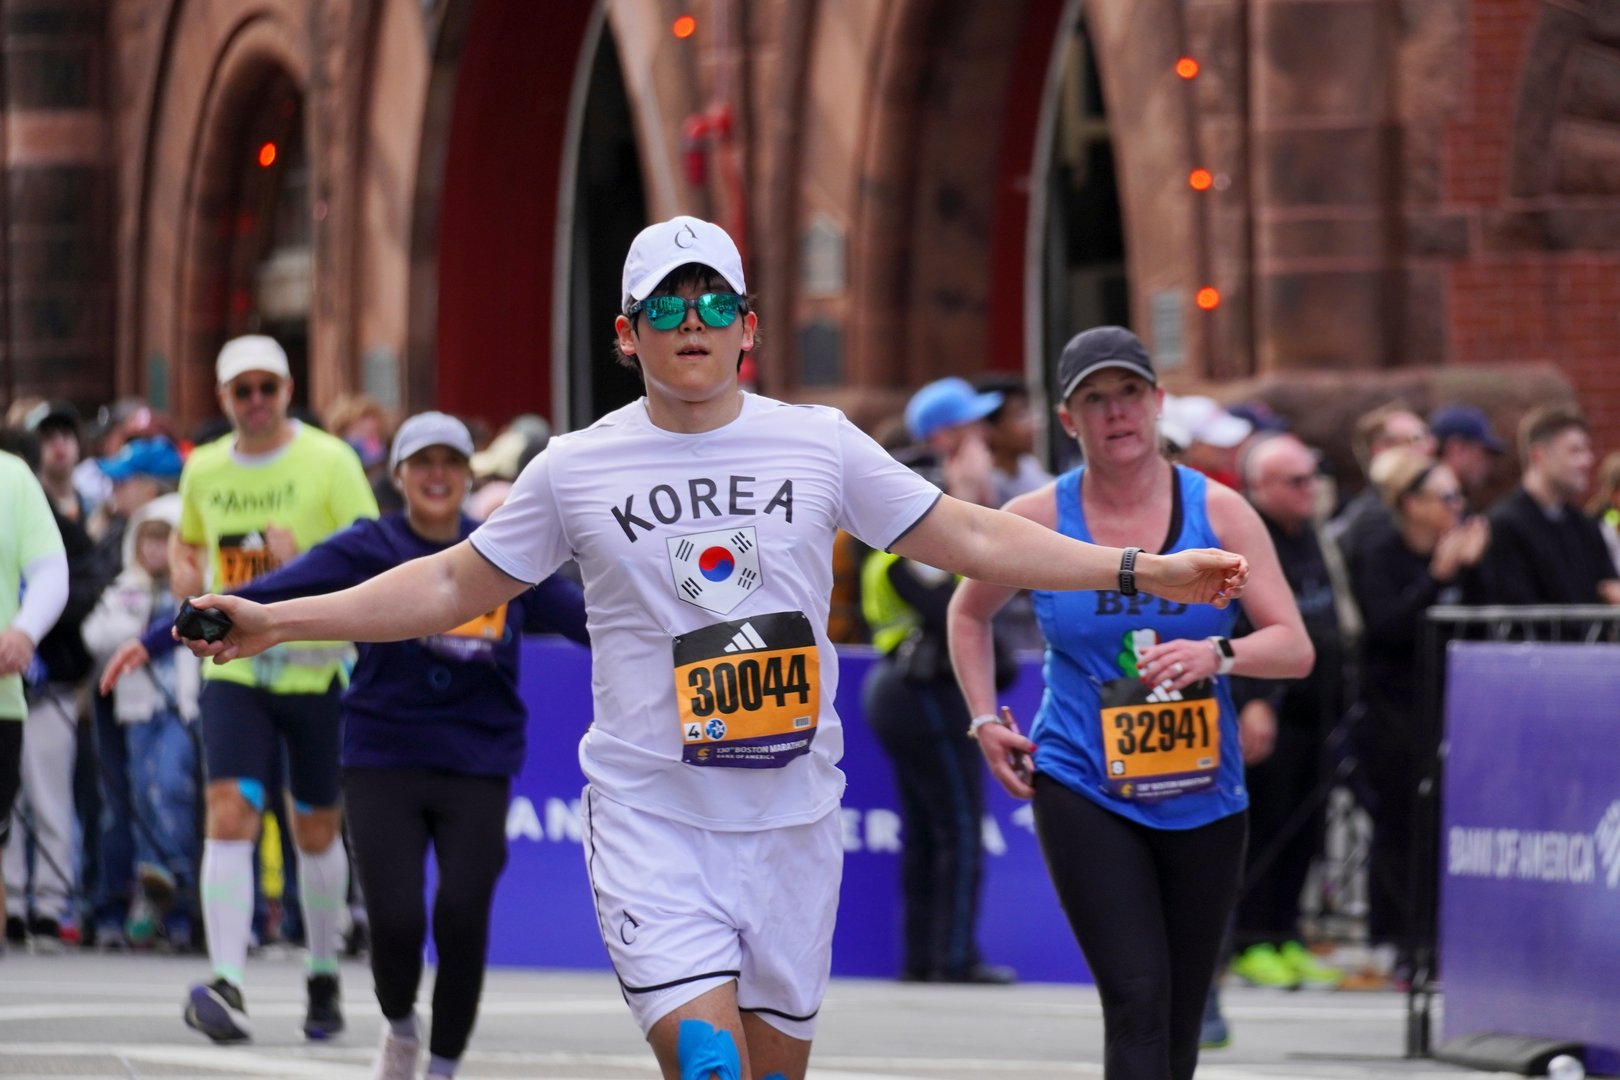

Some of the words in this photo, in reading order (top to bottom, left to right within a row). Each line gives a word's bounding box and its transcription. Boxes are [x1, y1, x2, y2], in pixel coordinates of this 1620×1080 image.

[611, 475, 793, 543] KOREA
[688, 654, 810, 717] 30044
[688, 725, 700, 738] 4
[735, 745, 769, 753] BOSTON
[1115, 706, 1210, 755] 32941
